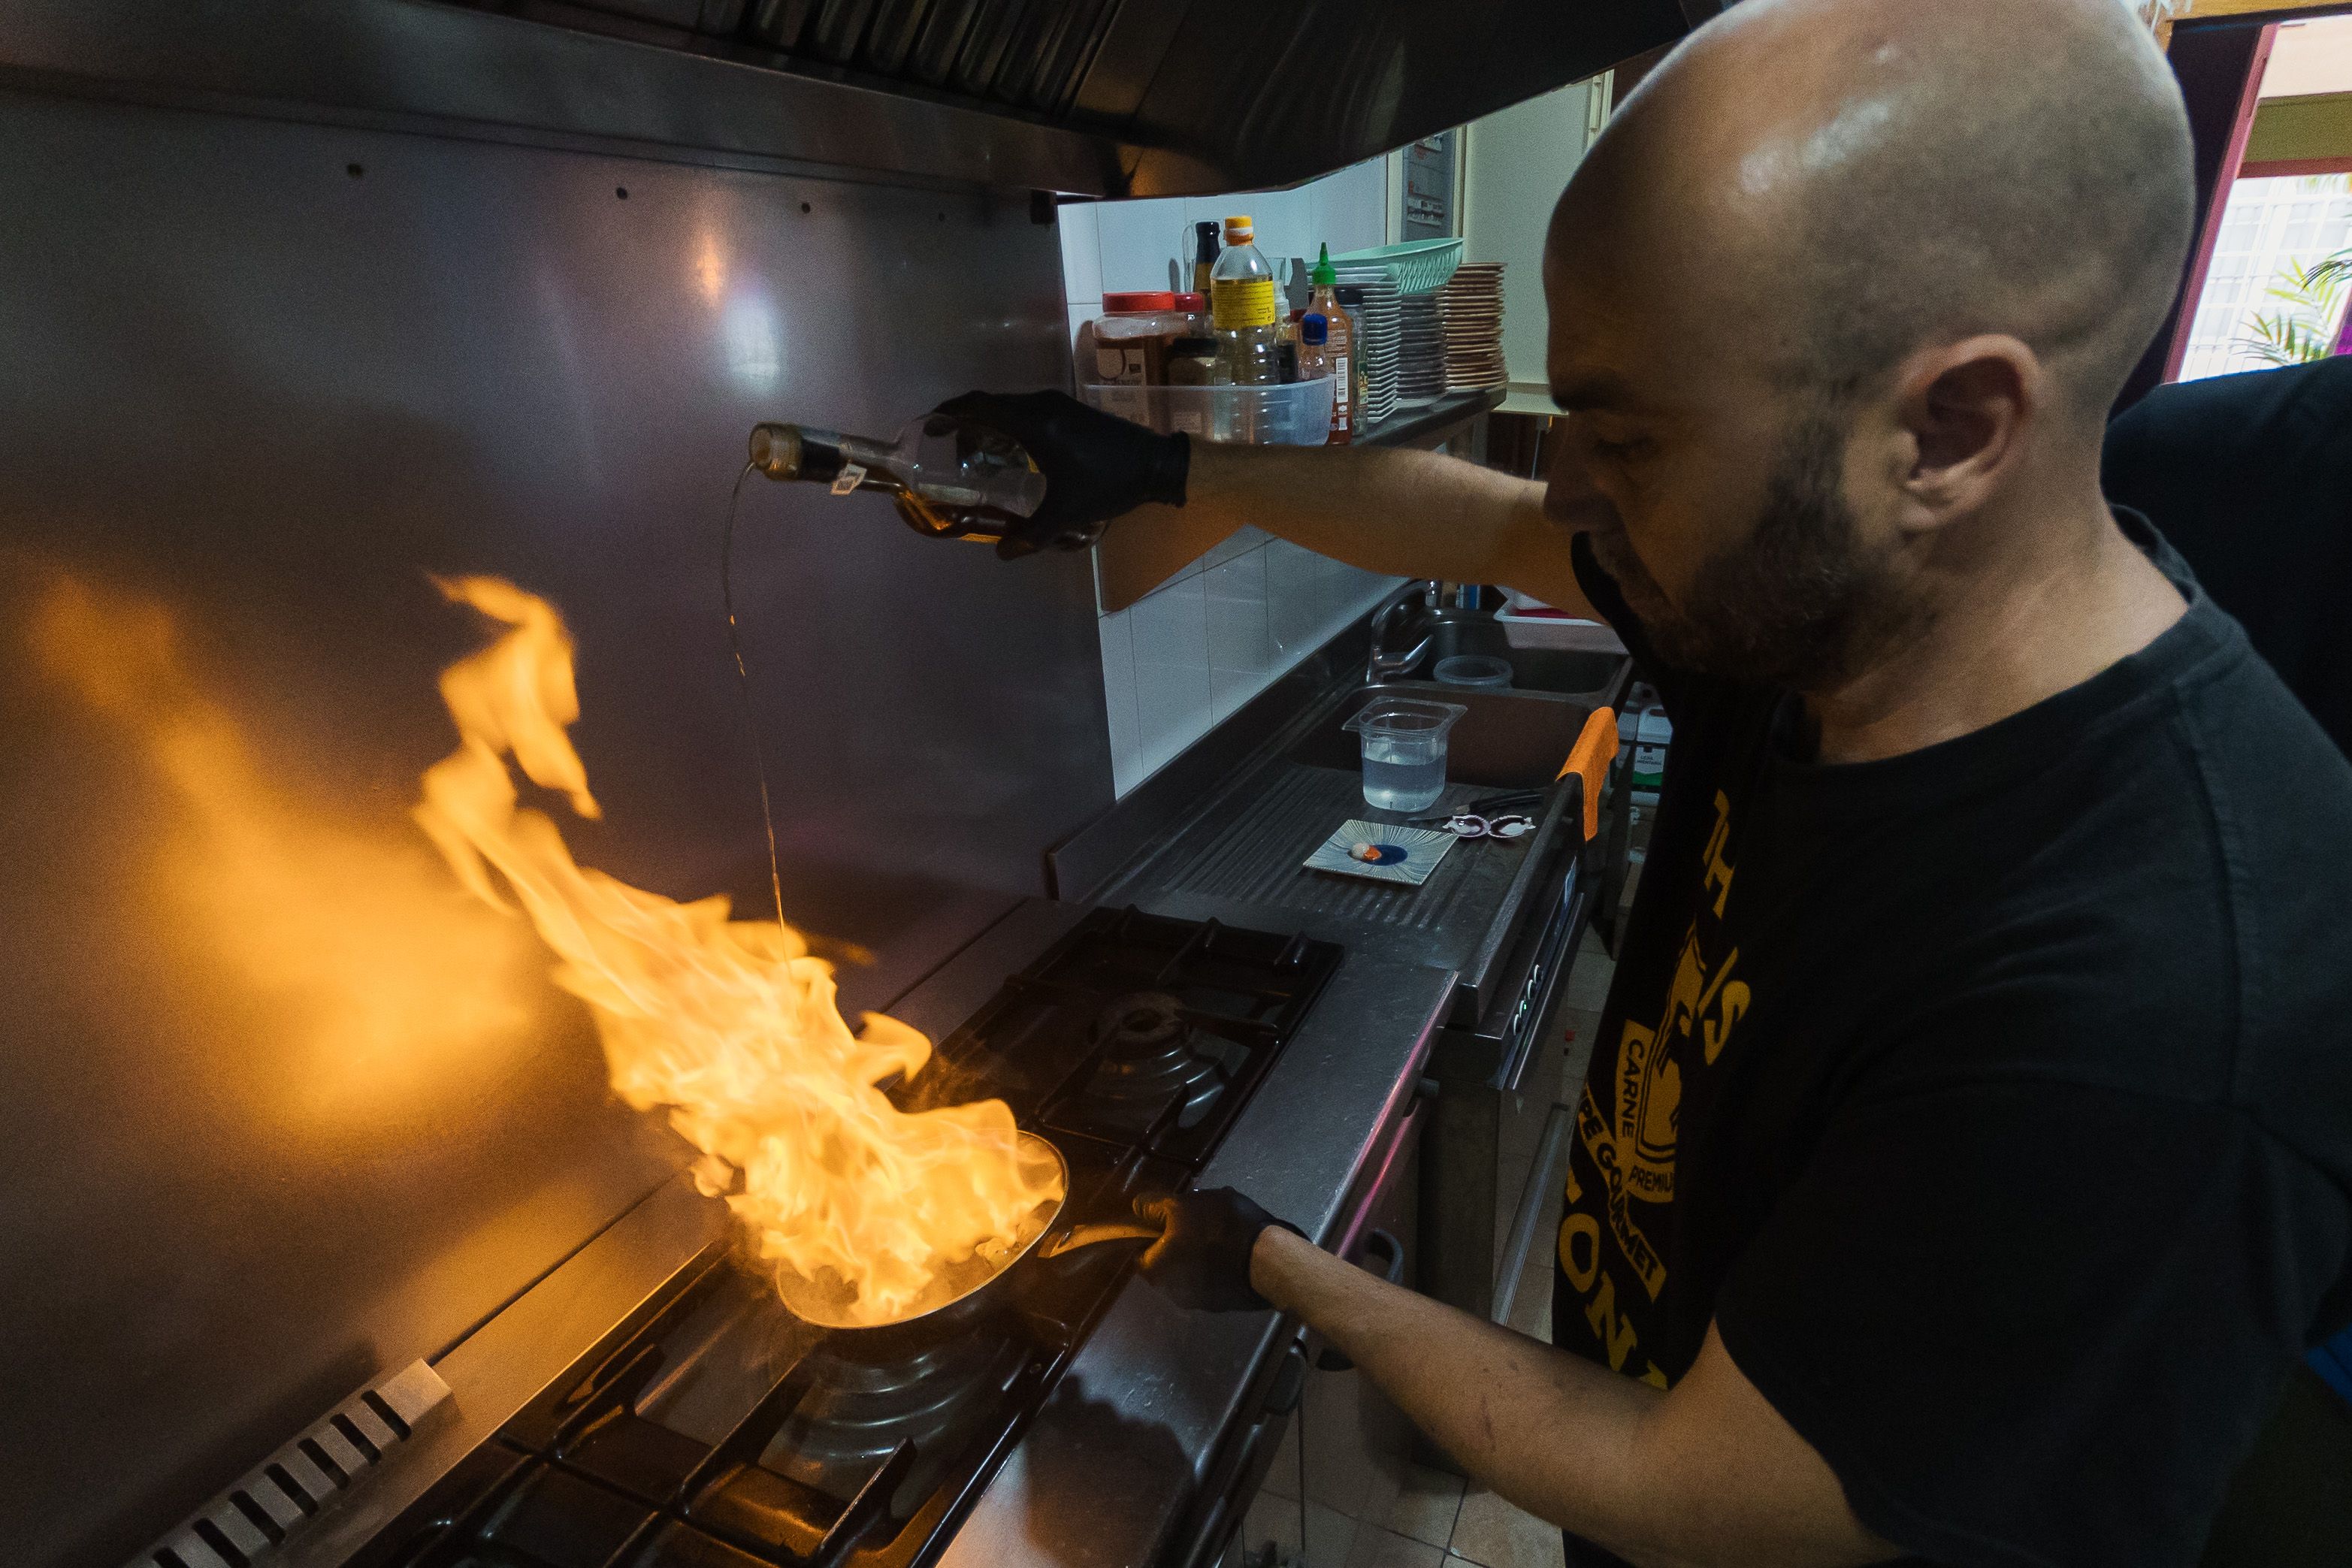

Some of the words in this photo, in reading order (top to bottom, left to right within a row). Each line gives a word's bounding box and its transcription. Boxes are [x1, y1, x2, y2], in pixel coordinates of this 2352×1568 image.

[1621, 1040, 1643, 1138] CARNE
[1579, 1093, 1603, 1141] PE
[1597, 1142, 1658, 1282] GOURMET
[1628, 1166, 1673, 1192] PREMIU
